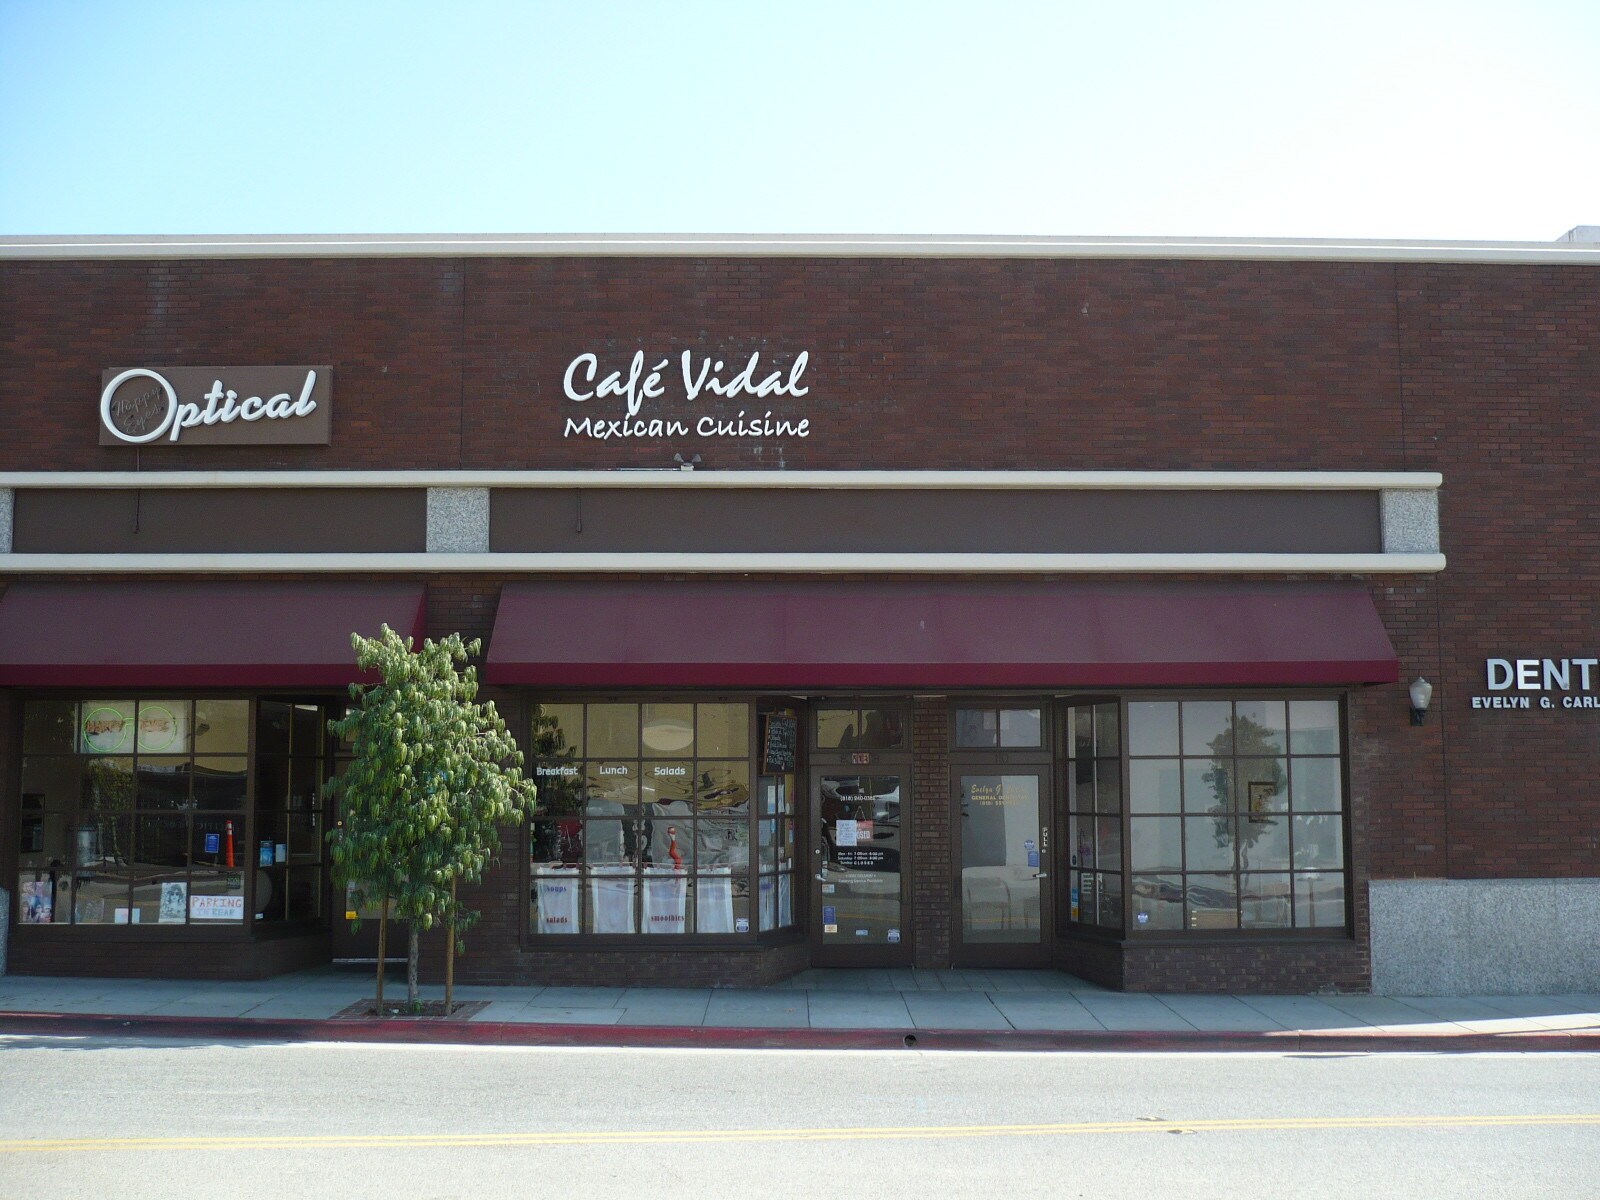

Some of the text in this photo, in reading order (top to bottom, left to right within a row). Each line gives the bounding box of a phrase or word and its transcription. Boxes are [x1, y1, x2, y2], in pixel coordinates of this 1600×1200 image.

[563, 350, 809, 416] Café Vidal
[101, 368, 317, 443] Optical
[564, 411, 810, 440] Mexican Cuisine
[1471, 696, 1530, 709] EVELYN
[1540, 696, 1555, 709] G.
[536, 767, 578, 776] Breakfast
[599, 766, 628, 775] Lunch
[654, 767, 686, 776] Salads
[546, 885, 567, 893] soups
[192, 896, 242, 908] PARKING
[546, 916, 568, 924] salads
